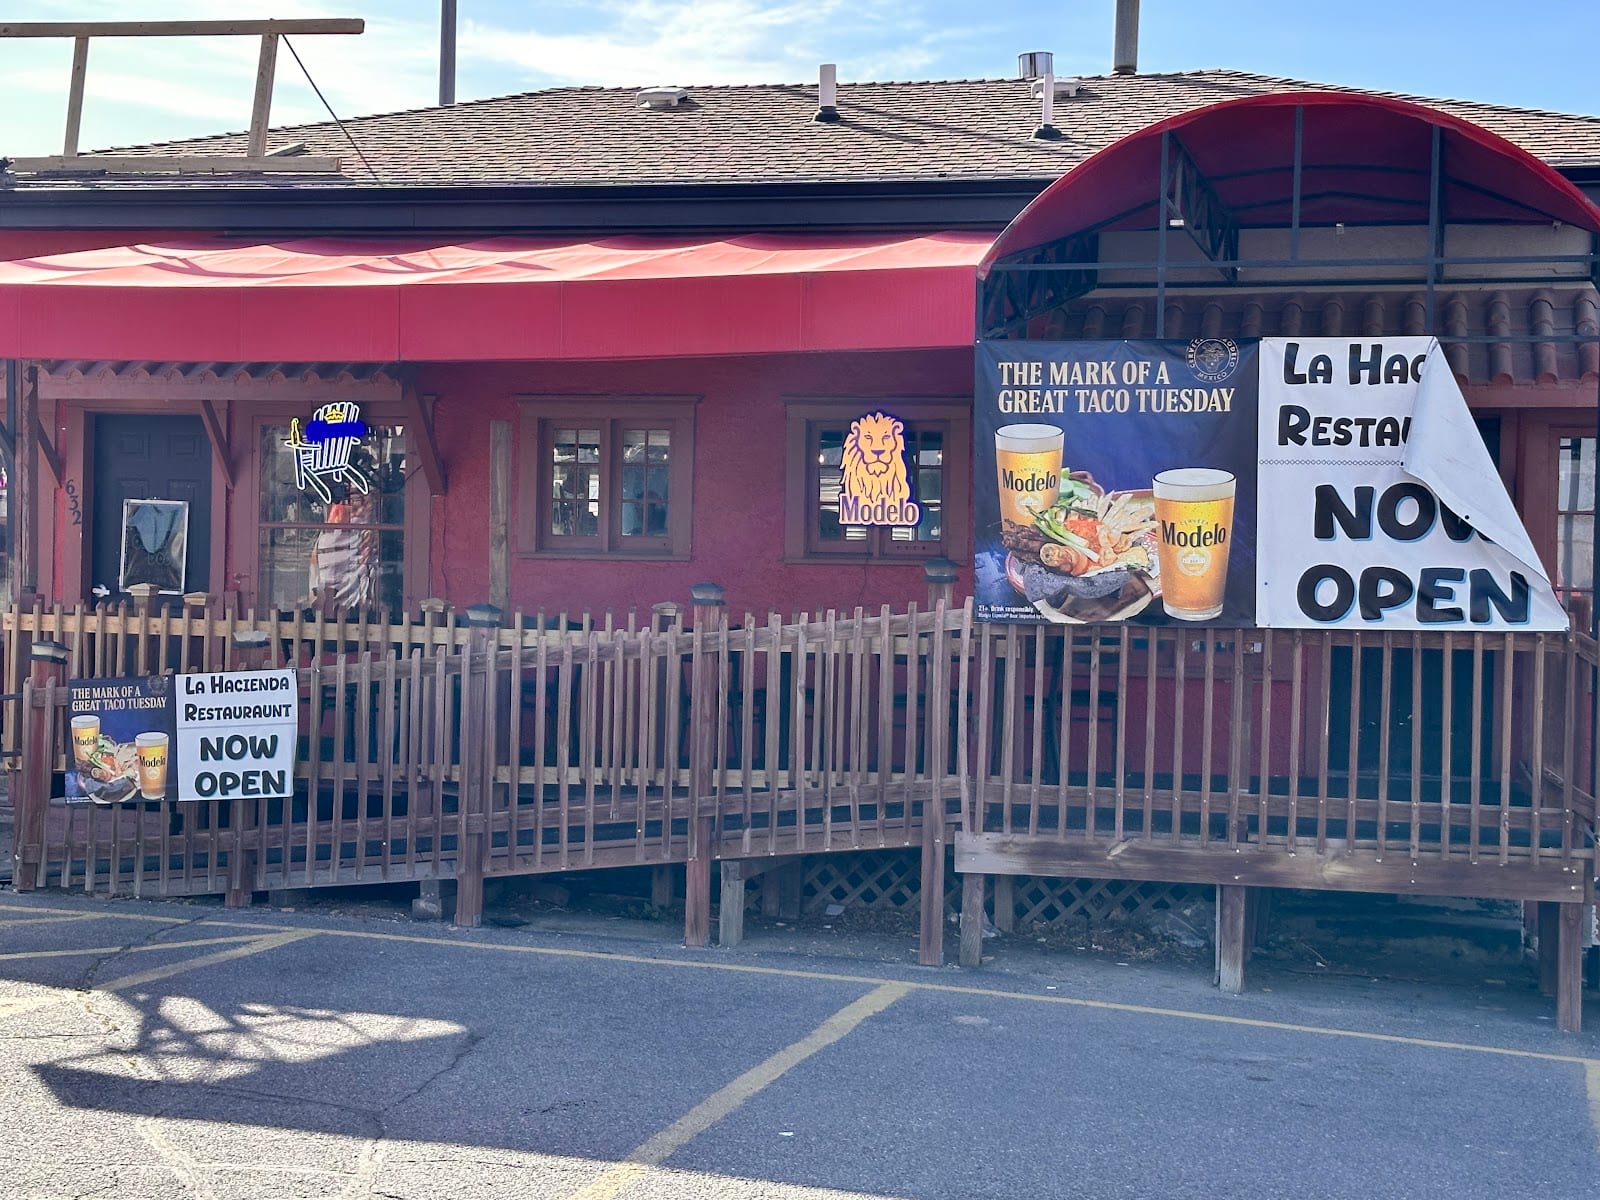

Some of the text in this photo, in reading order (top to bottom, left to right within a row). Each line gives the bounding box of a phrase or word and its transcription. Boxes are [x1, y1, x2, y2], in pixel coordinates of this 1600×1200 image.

[997, 361, 1171, 386] THE MARK OF A
[1197, 371, 1228, 381] MEXICO
[998, 387, 1236, 414] GREAT TACO TUESDAY
[1277, 404, 1412, 447] RESTA
[1002, 468, 1057, 492] Modelo
[841, 495, 917, 524] Modelo
[1161, 519, 1226, 548] Modelo
[1296, 563, 1532, 624] OPEN
[72, 687, 91, 700] THE
[92, 686, 120, 699] MARK
[121, 686, 133, 698] OF
[134, 685, 142, 697] A
[72, 697, 167, 712] GREAT TACO TUESDAY
[199, 734, 279, 761] NOW
[194, 770, 286, 798] OPEN
